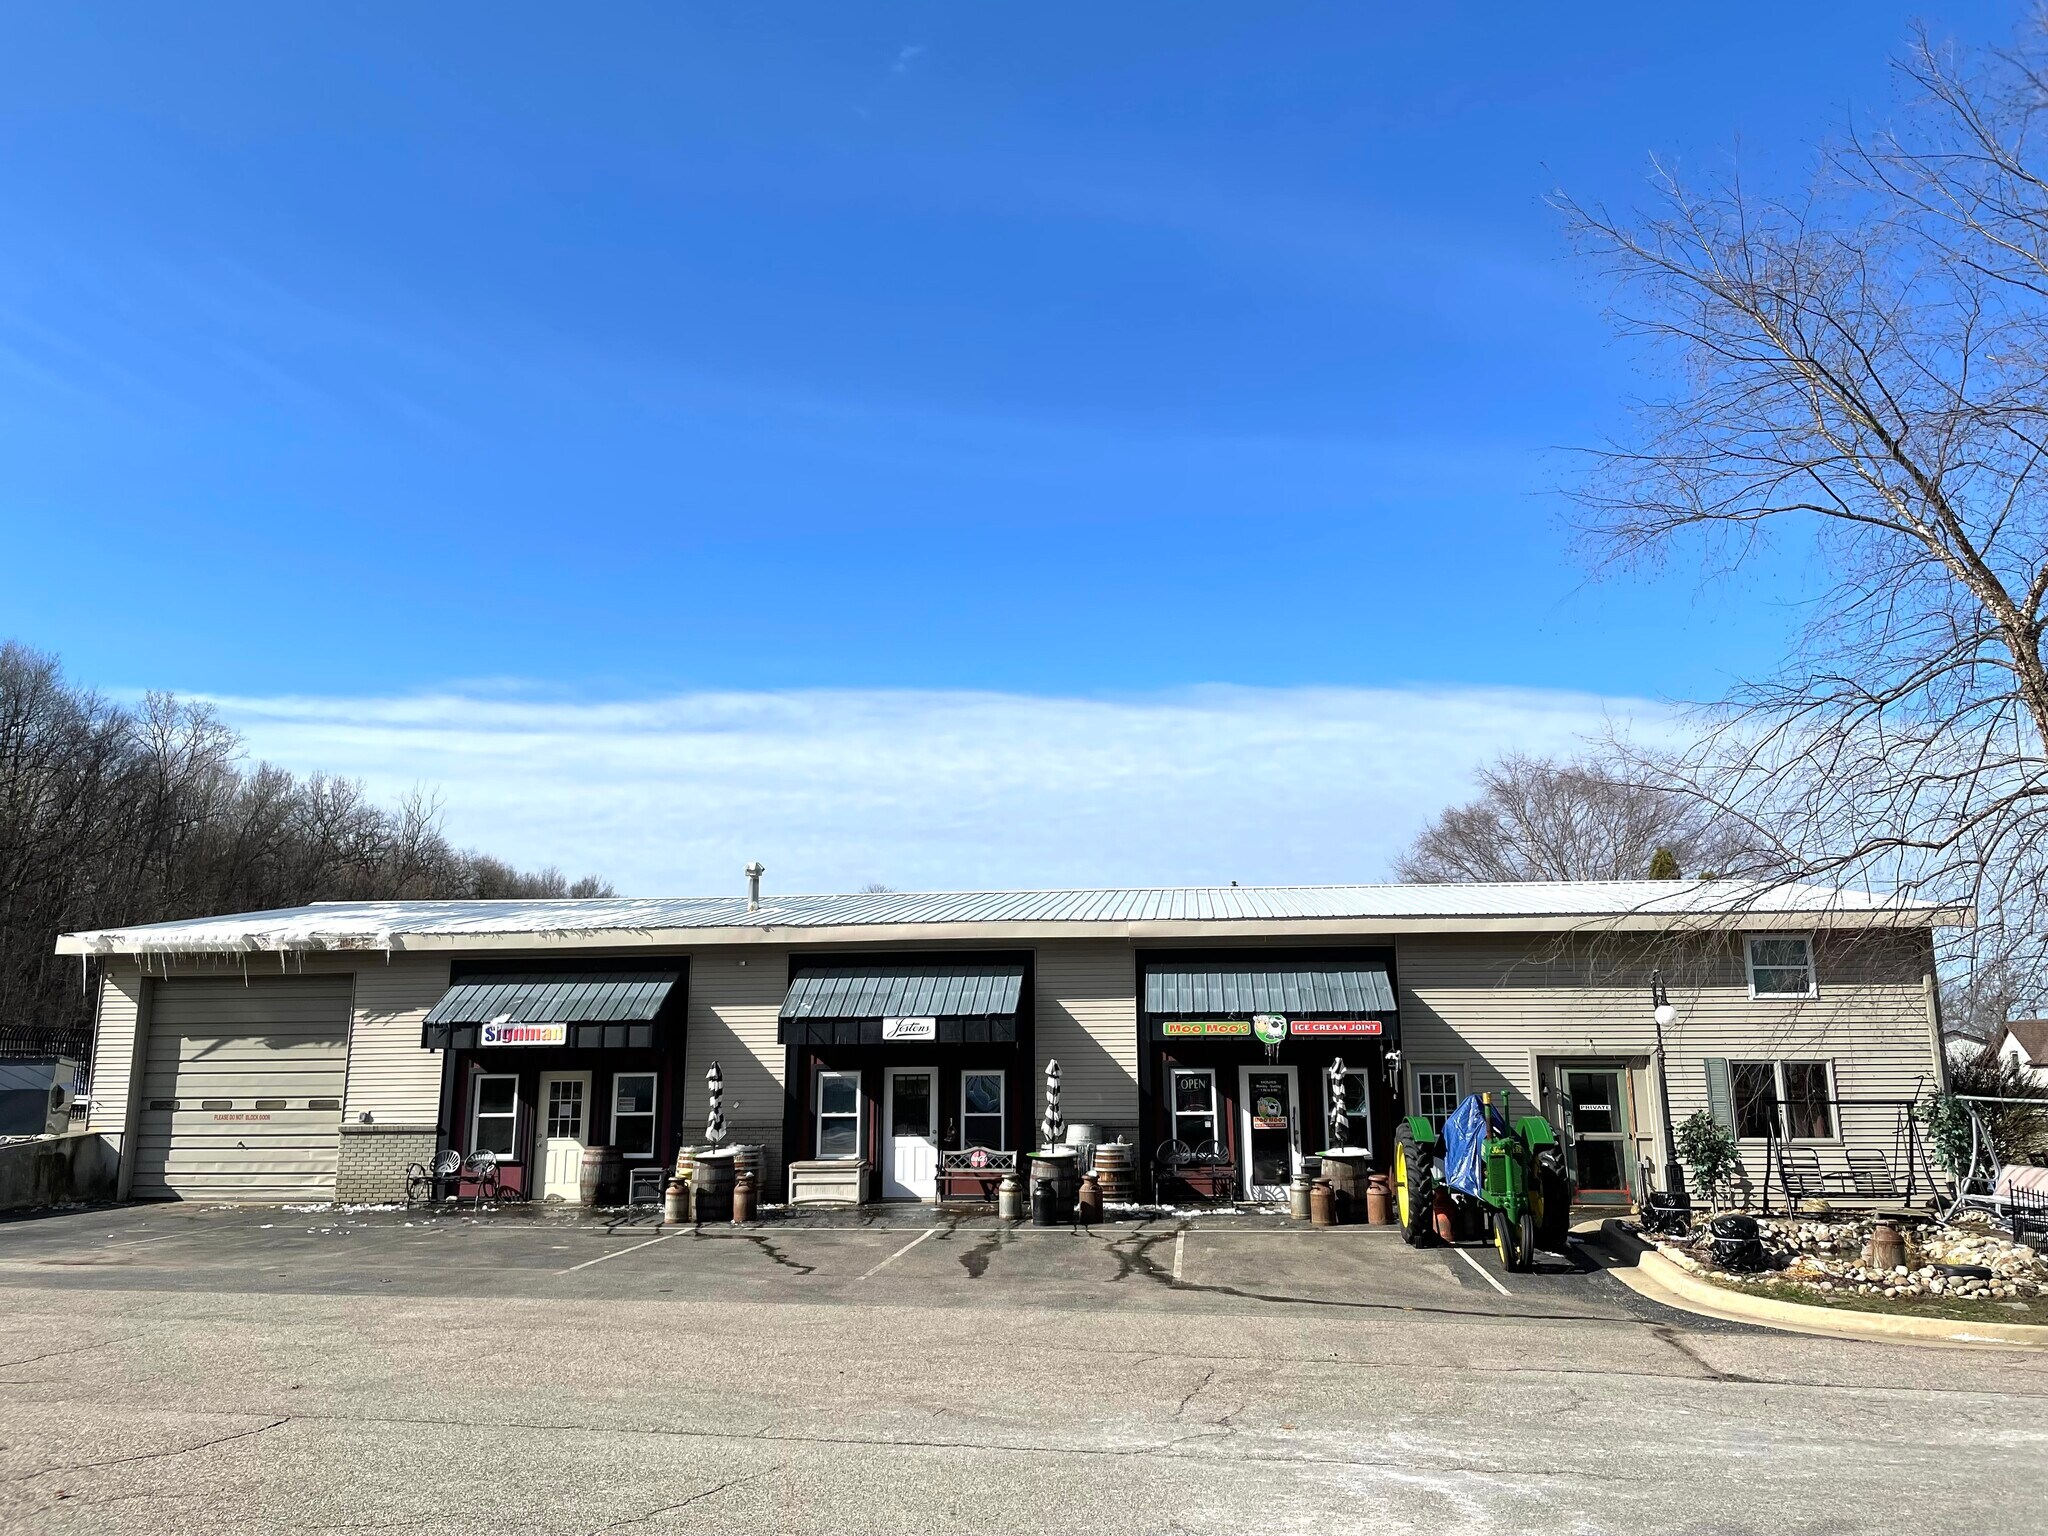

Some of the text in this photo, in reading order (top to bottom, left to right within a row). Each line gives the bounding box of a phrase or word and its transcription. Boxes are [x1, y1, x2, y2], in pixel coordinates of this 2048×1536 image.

[887, 1018, 931, 1038] Jostens
[1168, 1023, 1248, 1034] Moo Moo's
[1180, 1078, 1206, 1090] OPEN
